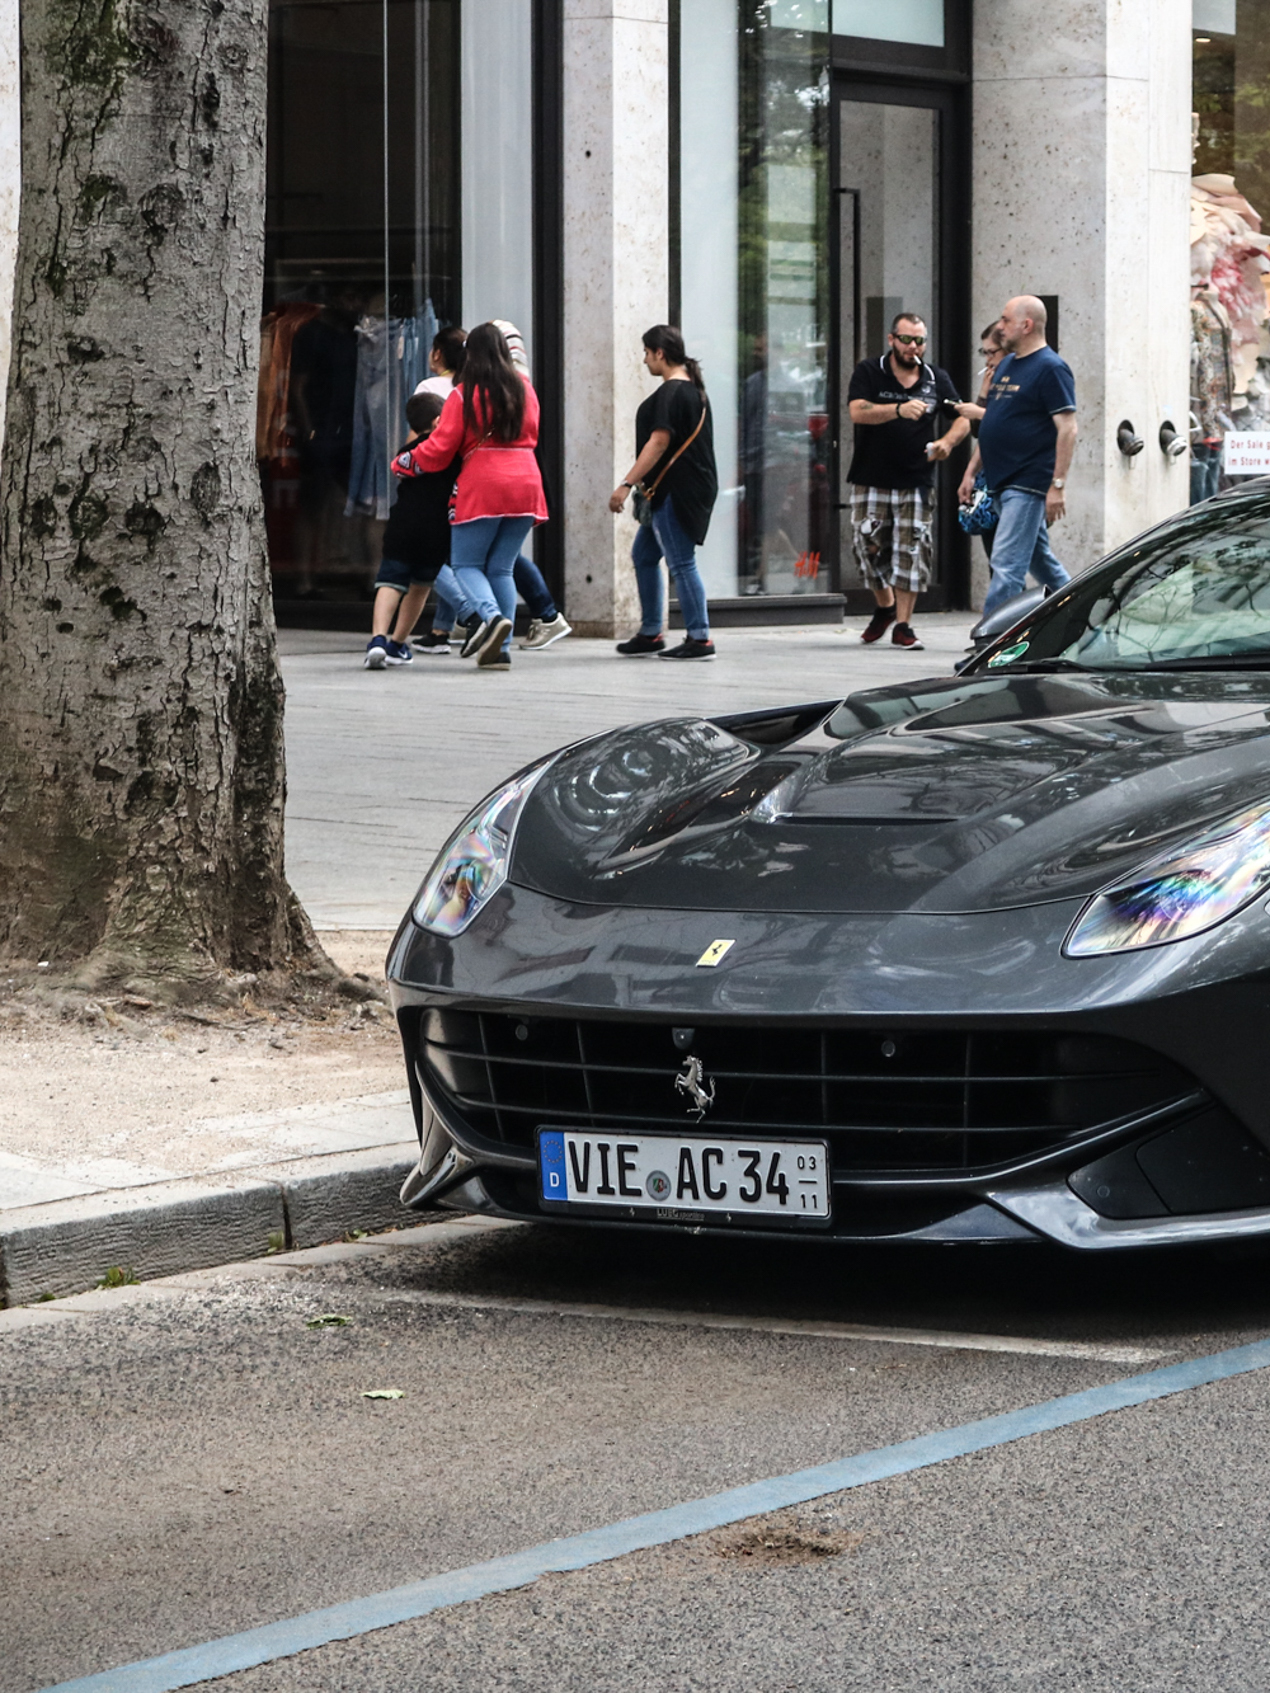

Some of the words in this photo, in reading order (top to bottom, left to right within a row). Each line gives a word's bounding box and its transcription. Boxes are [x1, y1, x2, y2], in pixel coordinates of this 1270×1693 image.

[1231, 440, 1244, 449] Der
[1247, 440, 1263, 449] Sale
[1241, 457, 1261, 466] Store
[797, 1155, 817, 1170] 03
[549, 1171, 560, 1187] D
[568, 1140, 642, 1196] VIE
[677, 1146, 727, 1201] AC
[737, 1149, 789, 1205] 34
[800, 1193, 818, 1209] 11
